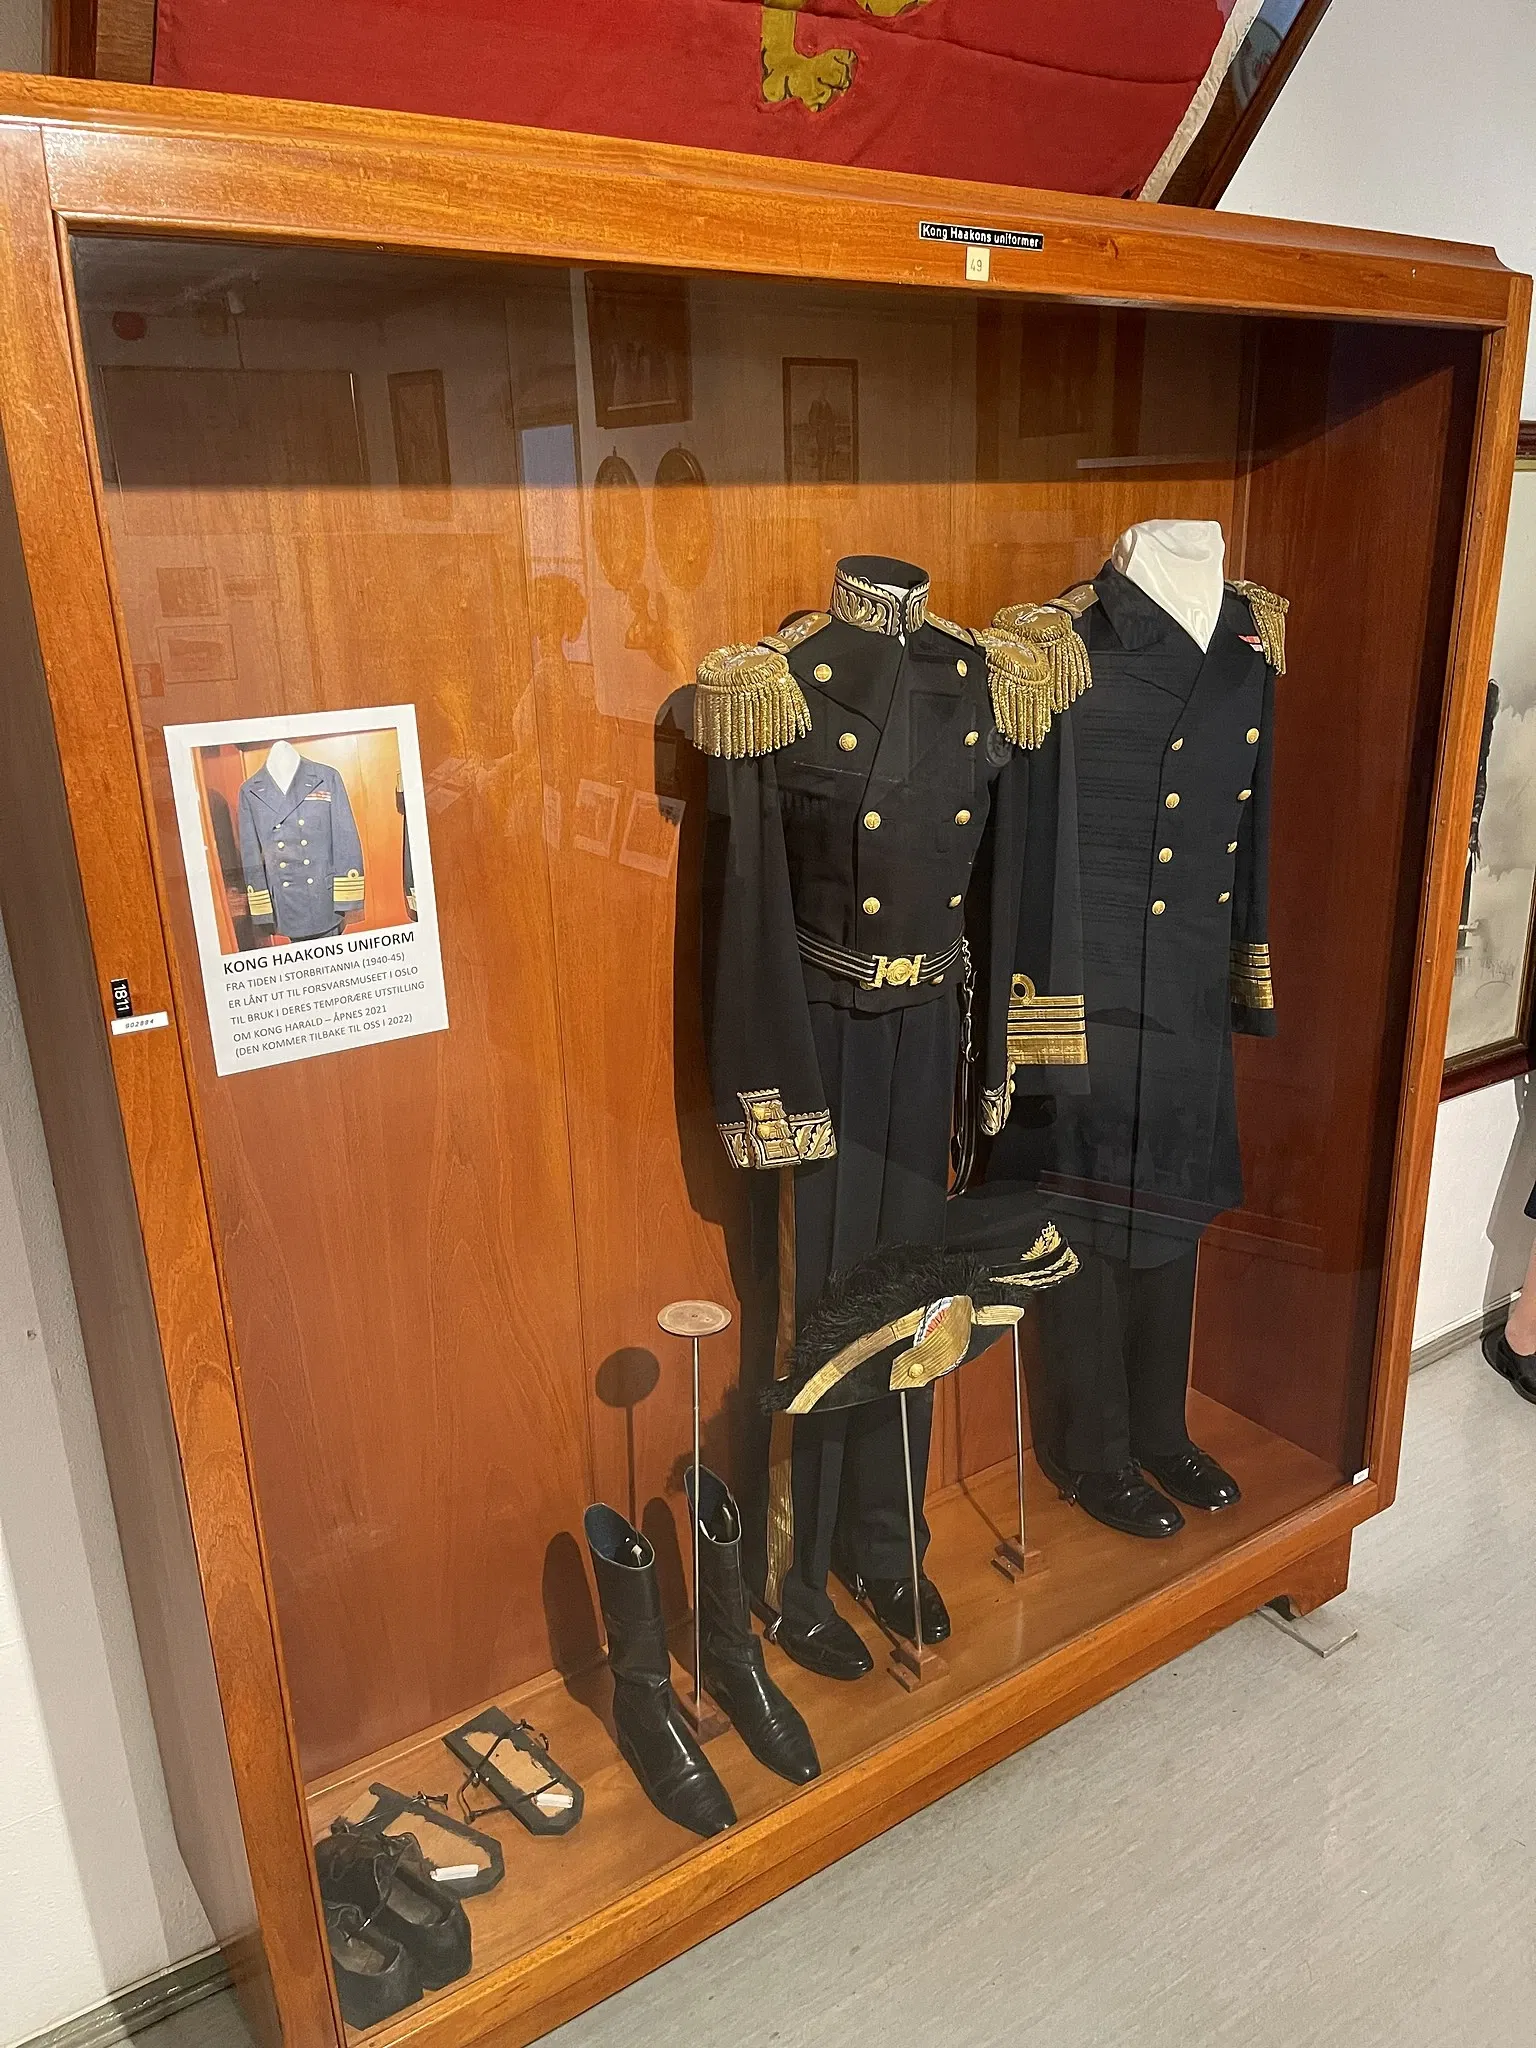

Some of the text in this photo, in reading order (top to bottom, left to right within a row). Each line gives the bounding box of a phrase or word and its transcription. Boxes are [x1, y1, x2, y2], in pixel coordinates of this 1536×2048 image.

[922, 224, 1039, 248] Kong Haakons uniformer
[970, 258, 983, 272] 49
[223, 931, 415, 974] KONG HAAKONS UNIFORM
[226, 952, 405, 992] FRA TIDEN I STORBRITANNIA (1940-45)
[113, 983, 130, 1011] 1811
[228, 966, 418, 1008] ER LÅNT UT TIL FORSVARSMUSEET I OSLO
[230, 981, 425, 1025] TIL BRUK I DERES TEMPORÆRE UTSTILLING
[233, 1031, 251, 1042] OM
[253, 1025, 283, 1038] KONG
[285, 1017, 323, 1032] HARALD
[333, 1011, 363, 1023] ÅPNES
[365, 1004, 388, 1016] 2021
[235, 1045, 260, 1058] (DEN
[262, 1035, 307, 1051] KOMMER
[309, 1027, 346, 1041] TILBAKE
[348, 1024, 361, 1034] TIL
[363, 1021, 381, 1031] OSS
[387, 1013, 413, 1026] 2022)
